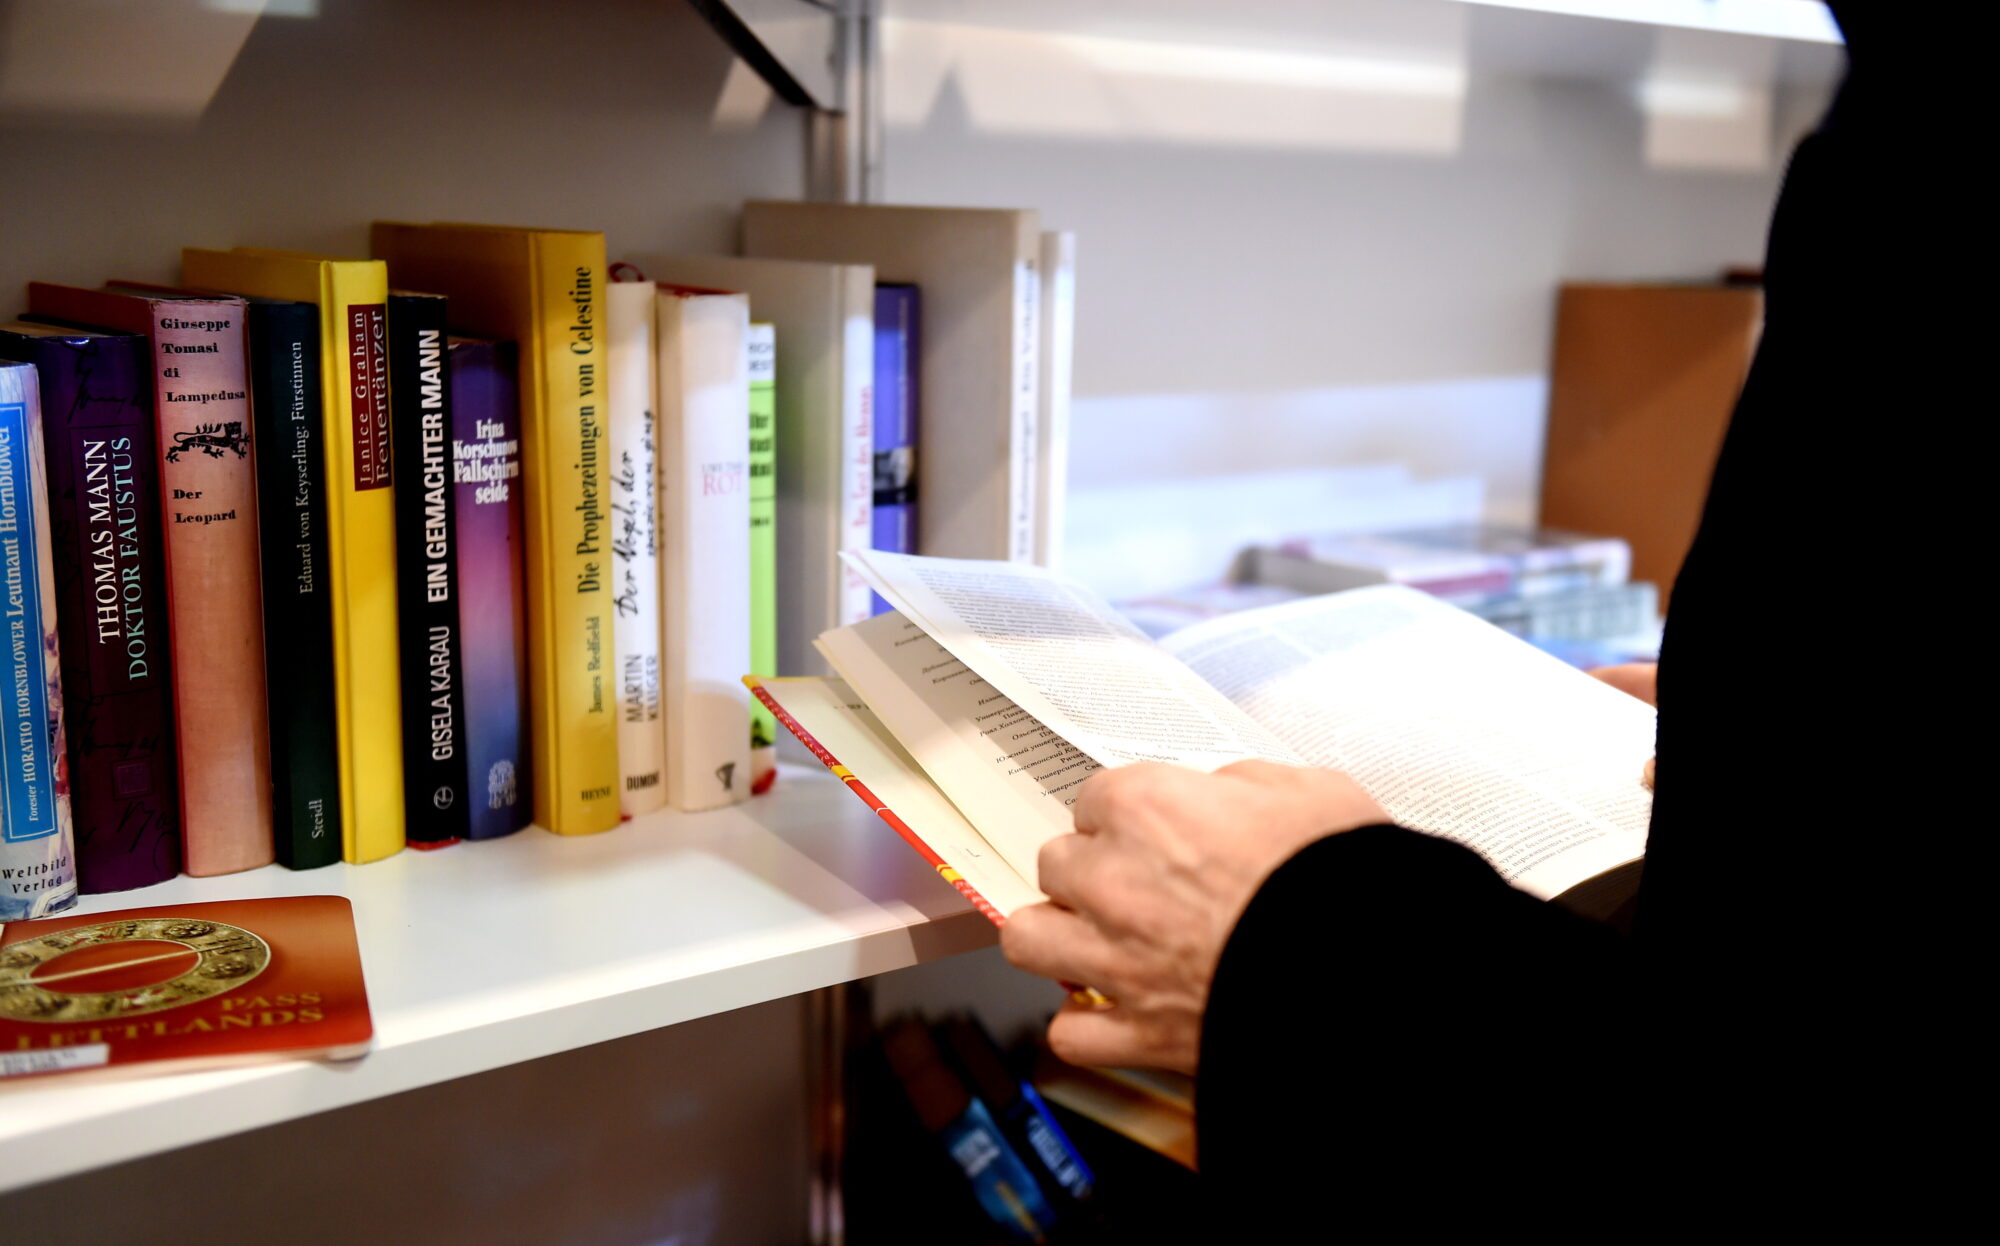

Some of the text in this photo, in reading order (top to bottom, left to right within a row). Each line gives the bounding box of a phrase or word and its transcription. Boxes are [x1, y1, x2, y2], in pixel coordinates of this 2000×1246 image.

[160, 317, 231, 333] Giuseppe
[162, 341, 218, 354] Tomasi
[163, 366, 180, 378] di
[165, 389, 246, 403] Lampedusa
[353, 312, 372, 483] Janice Graham
[372, 311, 389, 480] Feuertänzer
[476, 417, 505, 439] Irina
[569, 266, 603, 594] Die Prophezeiungen von Celestine
[292, 426, 311, 507] Keyserling:
[419, 330, 448, 603] EIN GEMACHTER MANN
[610, 451, 634, 492] der
[703, 470, 743, 496] ROT
[173, 488, 203, 500] Der
[475, 480, 509, 505] seide
[174, 509, 236, 525] Leopard
[300, 511, 310, 538] von
[84, 439, 120, 644] THOMAS MANN
[111, 437, 148, 681] DOKTOR FAUSTUS
[6, 537, 25, 617] Leutnant
[297, 543, 313, 593] Eduard
[614, 570, 638, 617] Der
[11, 620, 31, 718] HORNBLOWER
[625, 654, 643, 722] MARTIN
[430, 625, 453, 761] GISELA KARAU
[19, 721, 36, 783] HORATIO
[28, 785, 39, 822] Forester
[309, 799, 324, 839] Steidl
[1, 856, 67, 881] Weltbild
[12, 875, 63, 895] Verlag
[220, 992, 323, 1011] PASS
